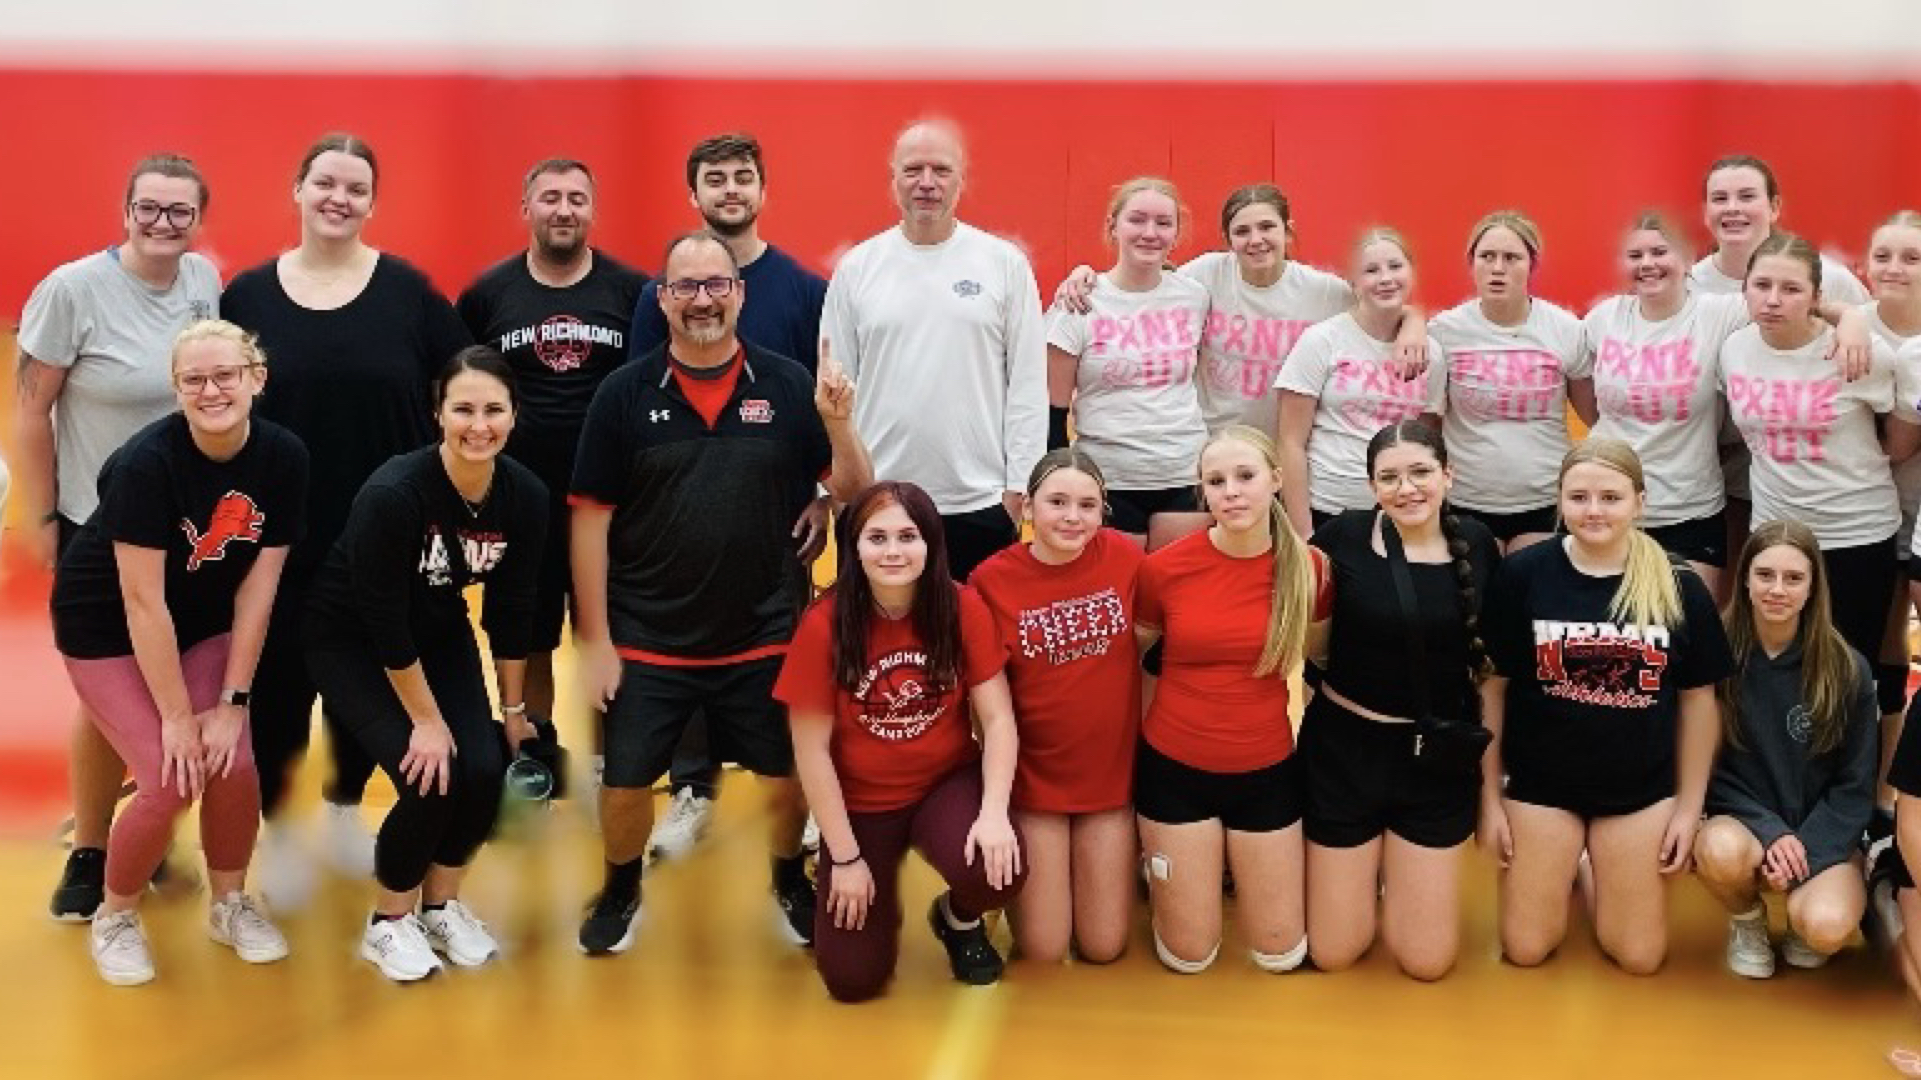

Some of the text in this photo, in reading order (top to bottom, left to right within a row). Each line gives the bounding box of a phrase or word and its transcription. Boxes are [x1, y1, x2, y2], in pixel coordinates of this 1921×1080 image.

[501, 325, 535, 353] NEW
[541, 323, 623, 349] RICHMOND
[1019, 597, 1127, 658] CHEER
